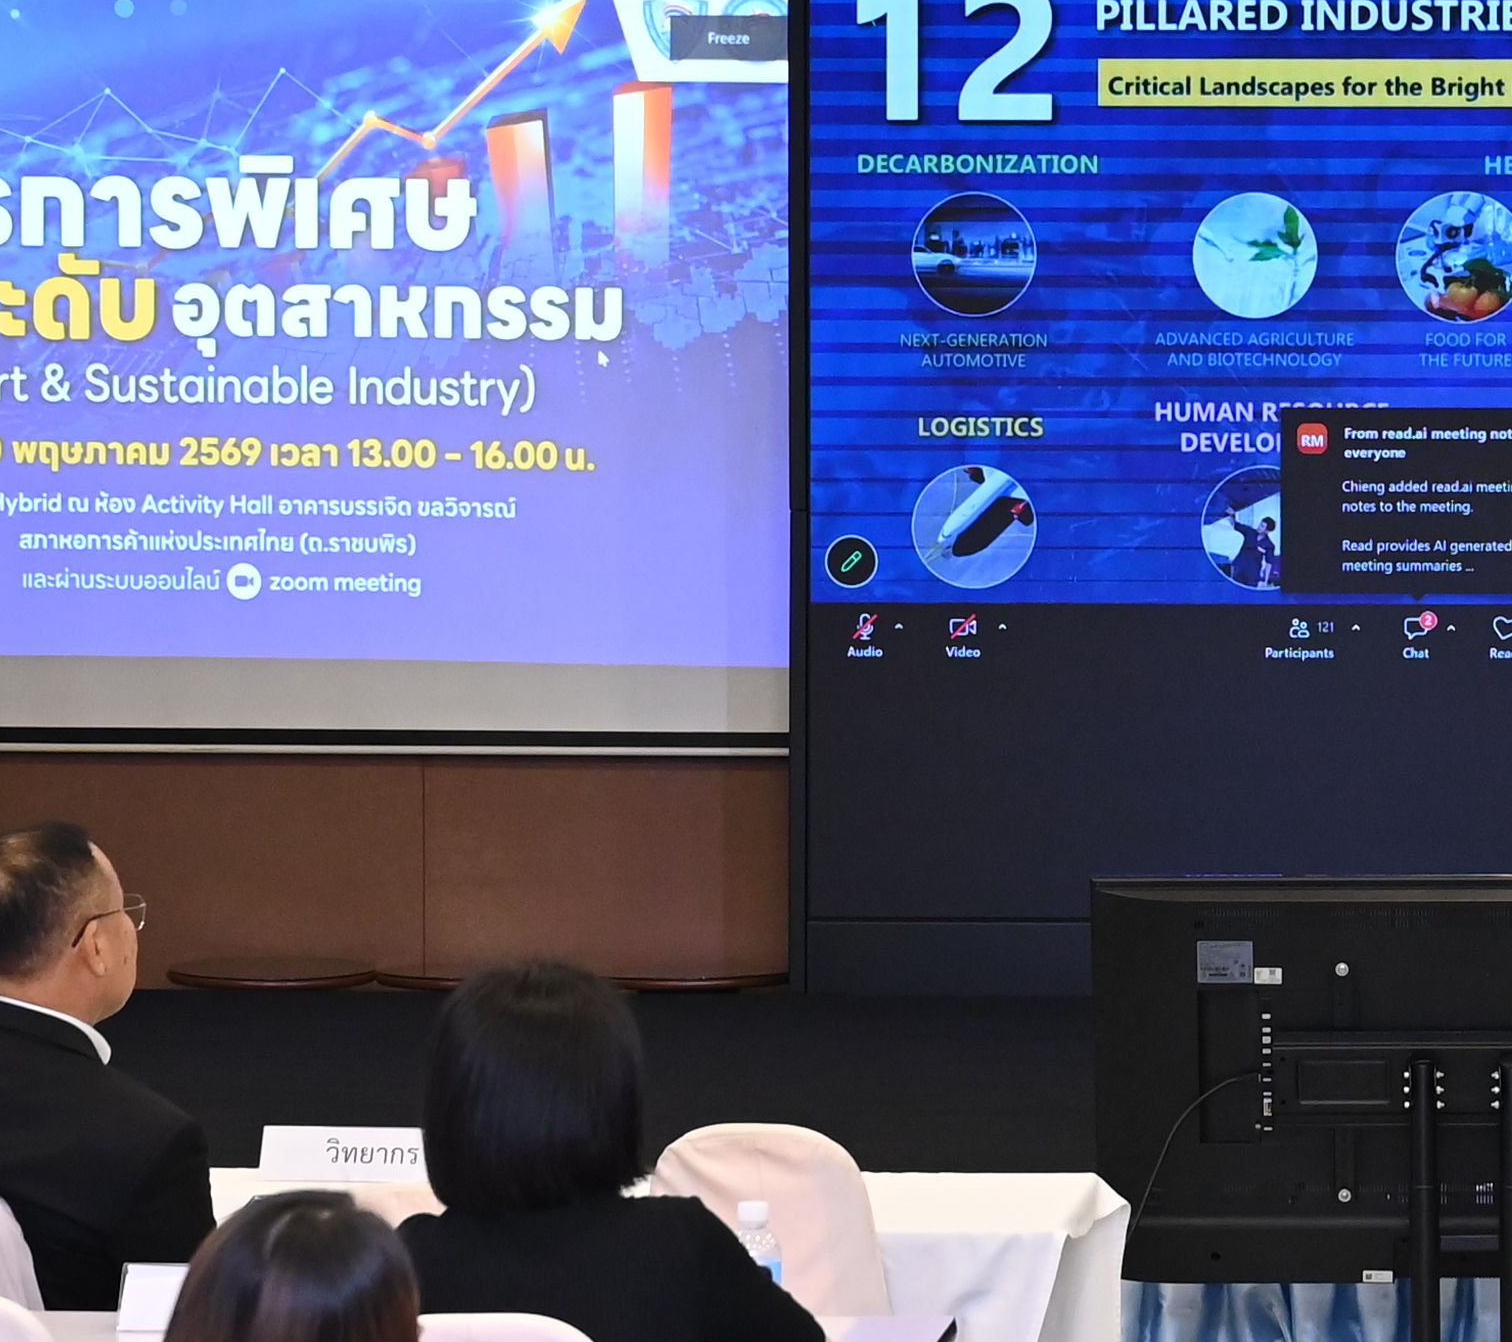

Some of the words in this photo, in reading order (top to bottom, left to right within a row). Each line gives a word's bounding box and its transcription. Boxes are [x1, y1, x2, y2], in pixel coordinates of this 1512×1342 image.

[707, 32, 750, 45] Freeze
[1108, 76, 1191, 96] Critical
[1200, 76, 1335, 102] Landscapes
[1342, 76, 1377, 96] for
[1384, 76, 1422, 96] the
[1431, 76, 1505, 102] Bright
[857, 154, 1099, 175] DECARBONIZATION
[172, 281, 623, 358] อุตสาหกรรม
[900, 333, 1048, 348] NEXT-GENERATION
[1155, 332, 1242, 347] ADVANCED
[1247, 332, 1355, 347] AGRICULTURE
[1425, 332, 1471, 347] FOOD
[1475, 332, 1507, 347] FOR
[921, 354, 1026, 368] AUTOMOTIVE
[1167, 352, 1203, 367] AND
[1207, 352, 1342, 367] BIOTECHNOLOGY
[1419, 353, 1448, 367] THE
[1453, 353, 1512, 367] FUTURE
[41, 363, 71, 404] &
[85, 364, 335, 406] Sustainable
[349, 365, 537, 417] Industry)
[1155, 402, 1255, 422] HUMAN
[918, 417, 1044, 437] LOGISTICS
[1344, 427, 1378, 440] From
[1382, 427, 1427, 440] read.ai
[1431, 427, 1486, 442] meeting
[1180, 432, 1281, 453] DEVELO
[1300, 434, 1324, 448] RM
[12, 438, 171, 472] พฤษภาคม
[179, 436, 262, 467] 2569
[270, 442, 339, 468] เวลา
[348, 438, 437, 469] 13.00
[470, 439, 558, 471] 16.00
[565, 446, 596, 471] น.
[1344, 448, 1406, 461] everyone
[1342, 480, 1385, 496] Chieng
[1388, 480, 1428, 493] added
[1431, 480, 1472, 493] read.ai
[67, 496, 89, 514] ณ
[95, 491, 136, 515] ห้อง
[141, 493, 225, 518] Activity
[230, 494, 273, 516] Hall
[278, 495, 412, 517] อาคารบรรเจิด
[1342, 501, 1376, 513] notes
[1379, 502, 1395, 513] to
[1398, 500, 1417, 513] the
[1420, 501, 1473, 516] meeting.
[19, 527, 294, 553] สภาหอการค้าแห่งประเทศไทย
[1342, 539, 1373, 552] Read
[1377, 539, 1430, 554] provides
[1433, 539, 1447, 552] AI
[1450, 539, 1512, 554] generated
[1342, 560, 1392, 575] meeting
[1395, 560, 1462, 572] summaries
[22, 566, 221, 590] และผ่านระบบออนไลน์
[269, 574, 328, 592] zoom
[334, 571, 422, 598] meeting
[1317, 621, 1335, 633] 121
[1424, 615, 1434, 626] 2
[847, 645, 883, 658] Audio
[945, 645, 981, 658] Video
[1265, 646, 1335, 661] Participants
[1403, 647, 1429, 659] Chat
[326, 1138, 419, 1165] วิทยากร
